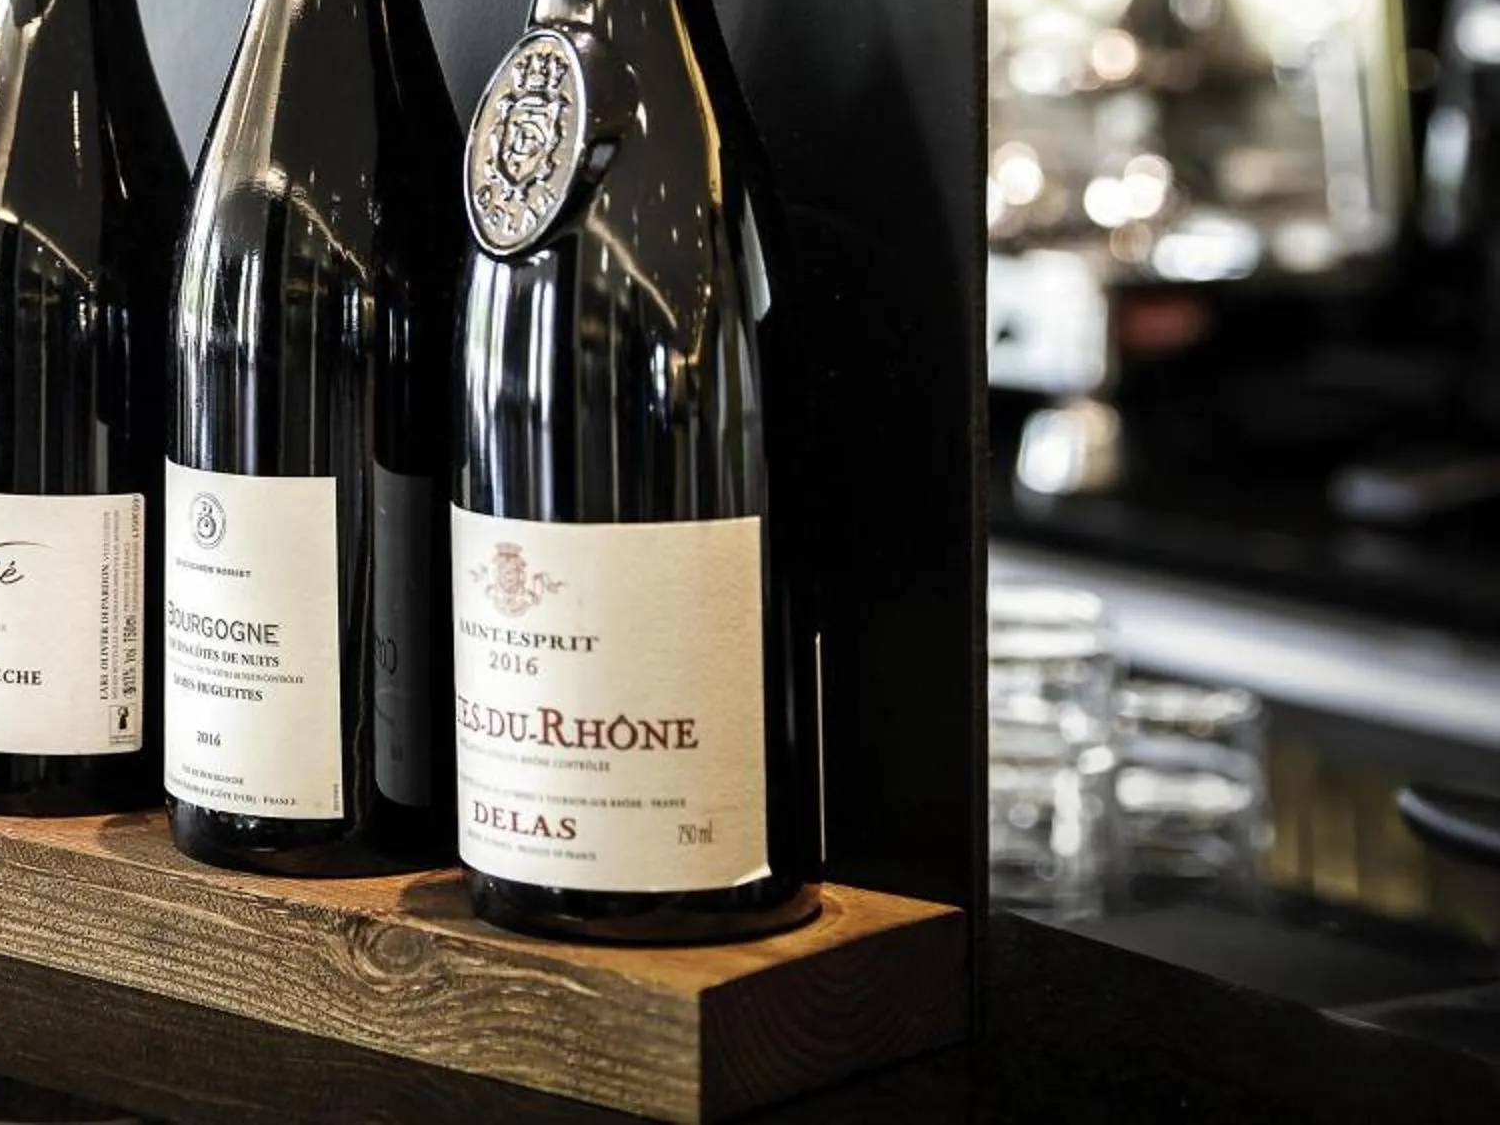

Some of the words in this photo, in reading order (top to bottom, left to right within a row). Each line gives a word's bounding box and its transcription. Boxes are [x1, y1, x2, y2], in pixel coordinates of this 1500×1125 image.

[167, 600, 280, 647] BOURGOGNE
[488, 649, 539, 676] 2016
[457, 693, 699, 751] TES-DU-RHÔNE
[473, 800, 577, 841] DELAS
